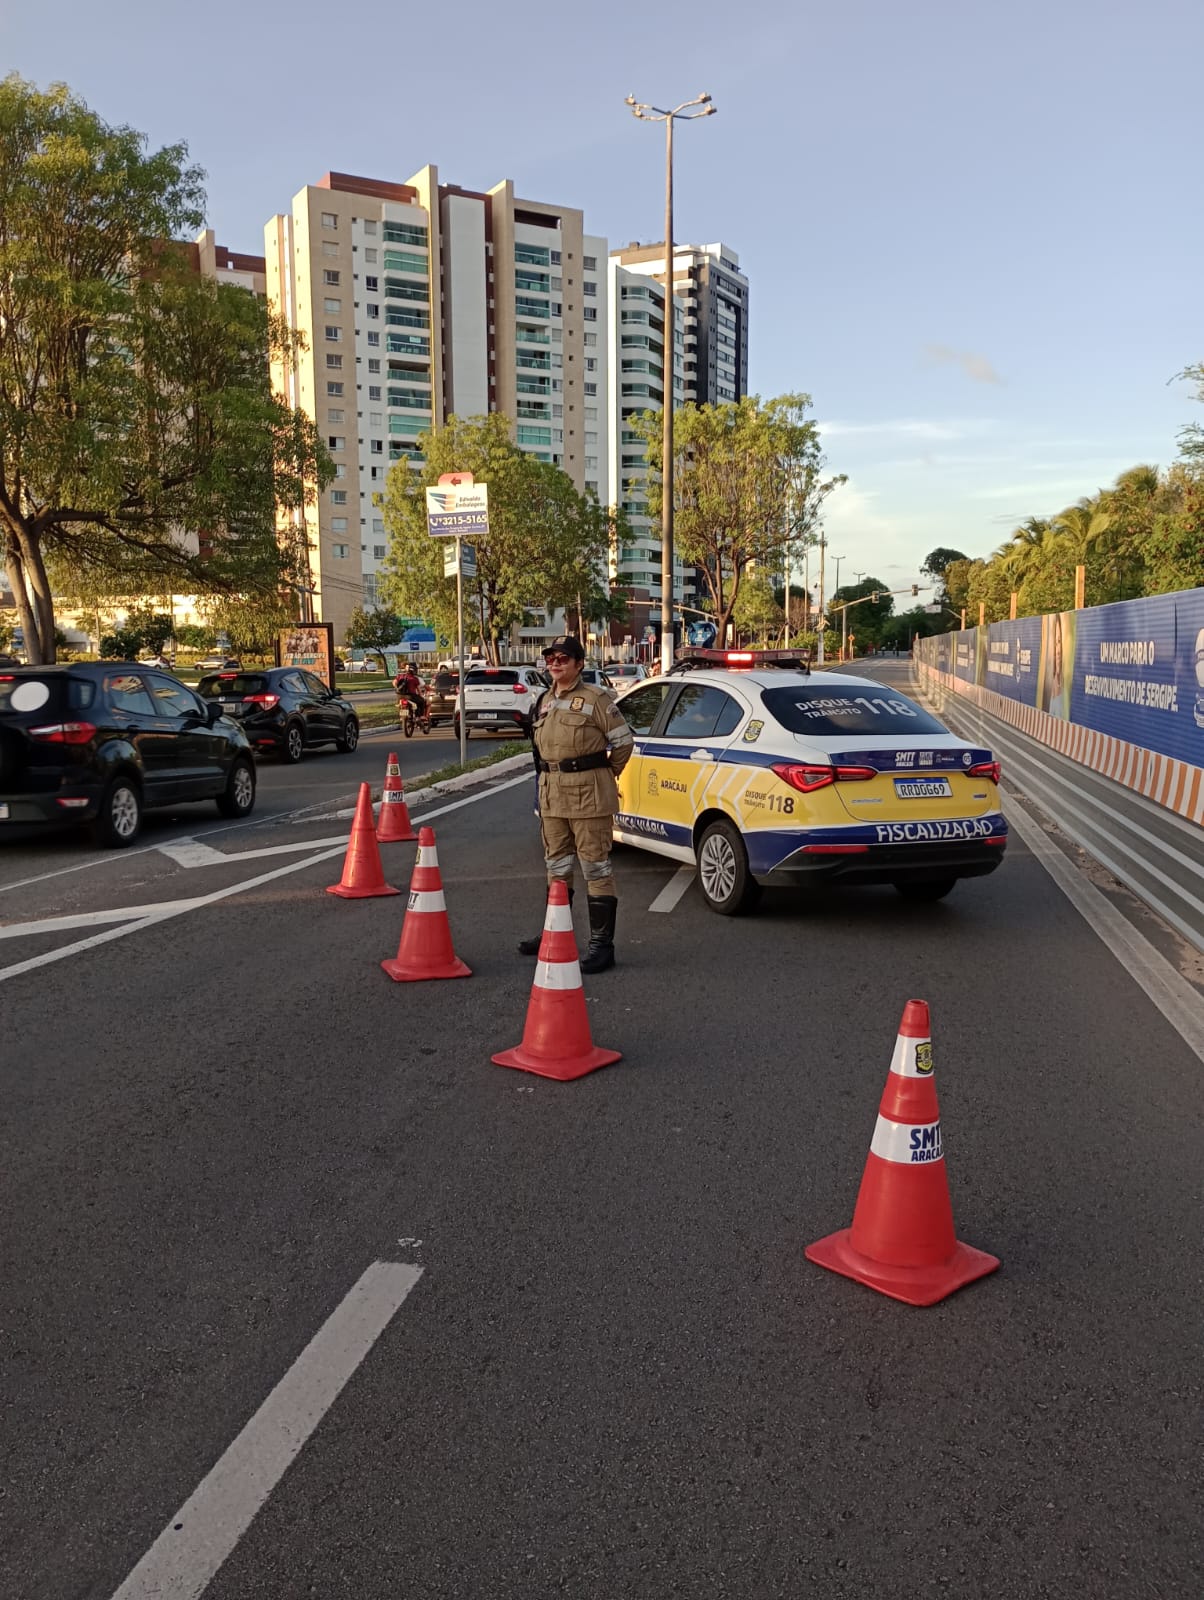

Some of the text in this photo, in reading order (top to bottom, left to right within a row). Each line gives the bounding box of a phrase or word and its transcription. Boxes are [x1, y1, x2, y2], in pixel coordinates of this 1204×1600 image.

[442, 514, 487, 525] 3215-5165
[1109, 642, 1129, 664] MARCO
[1130, 641, 1148, 665] PARA
[1149, 641, 1155, 666] O
[1136, 681, 1146, 705] DE
[795, 697, 918, 717] DISQUE 118
[895, 752, 915, 762] SMTT
[745, 790, 795, 814] DISQUE 118
[875, 818, 994, 842] FISCALIZAÇÃO
